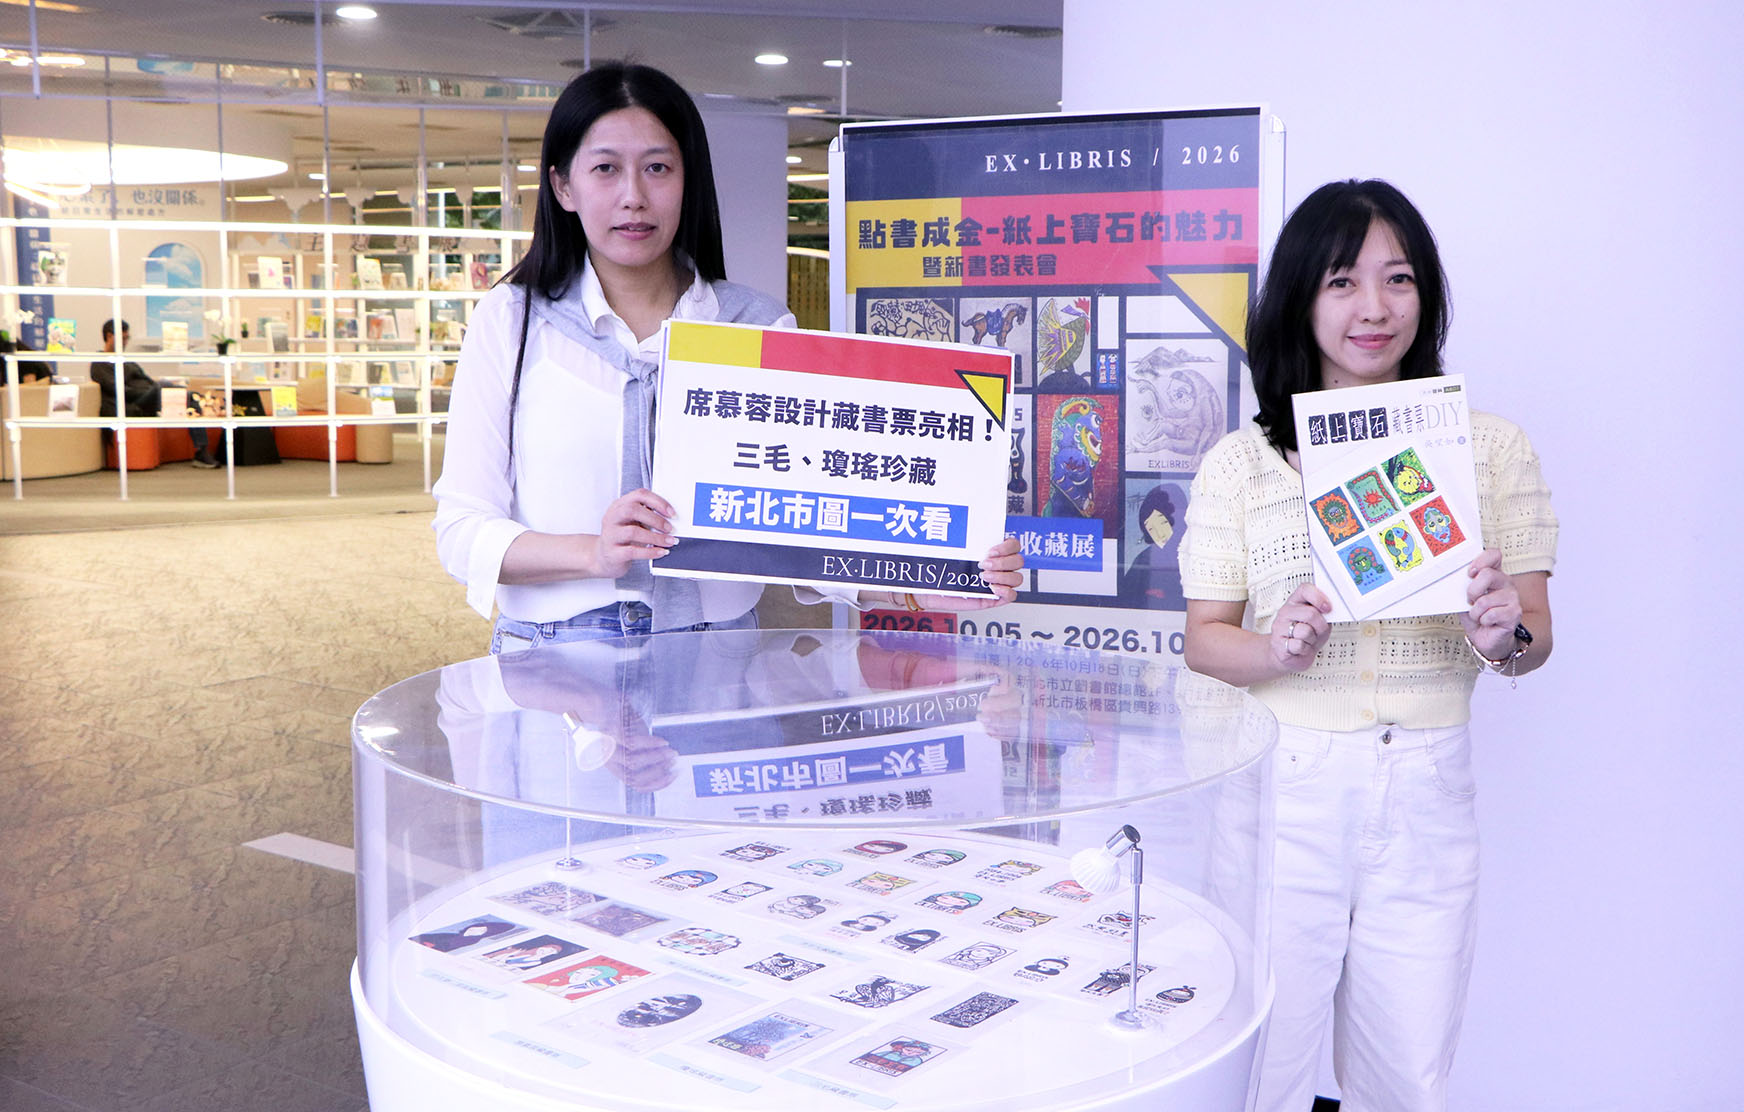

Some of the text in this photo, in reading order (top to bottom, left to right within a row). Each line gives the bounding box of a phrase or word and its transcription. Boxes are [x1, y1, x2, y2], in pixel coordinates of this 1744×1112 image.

[1181, 144, 1240, 166] 2026
[858, 209, 1244, 250] 點書成金-紙上寶石的魅力
[922, 253, 1057, 279] 暨新書發表會
[684, 388, 993, 442] 席慕蓉設計藏書票亮相！
[1309, 408, 1388, 445] 紙上寶石
[733, 442, 937, 487] 三毛、瓊瑤珍藏
[709, 487, 952, 542] 新北市圖一次看
[1004, 531, 1095, 559] 收藏展
